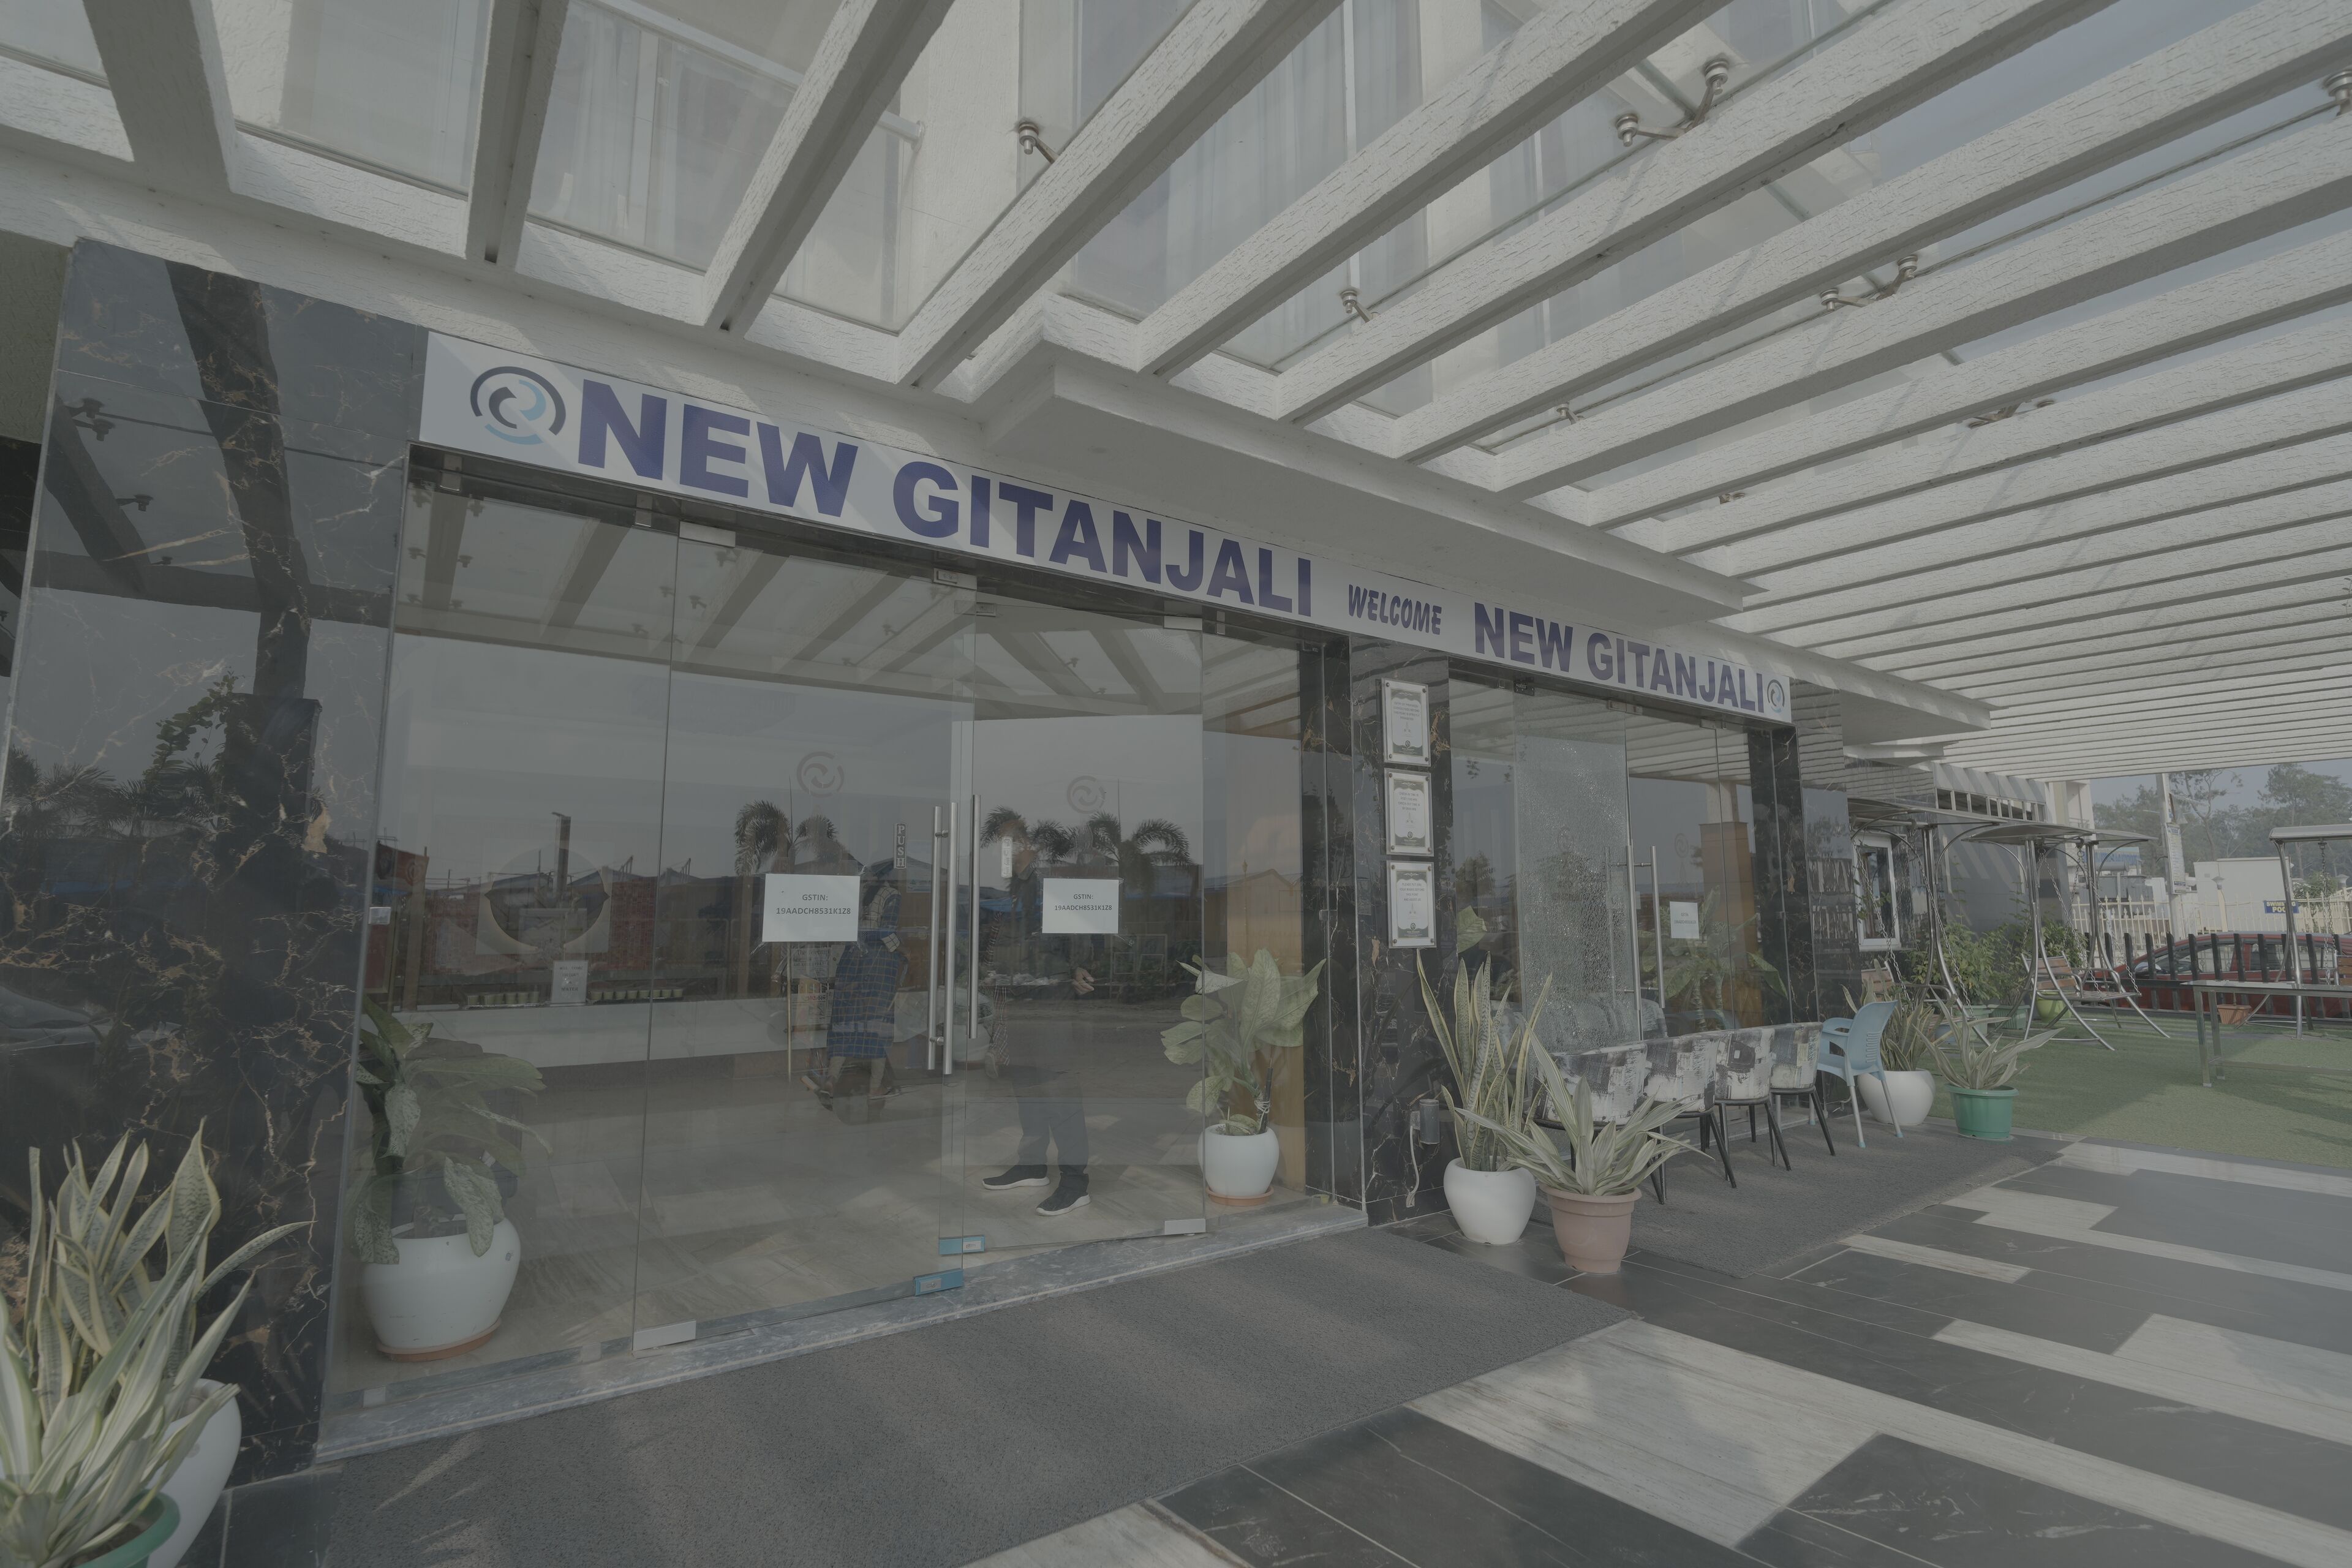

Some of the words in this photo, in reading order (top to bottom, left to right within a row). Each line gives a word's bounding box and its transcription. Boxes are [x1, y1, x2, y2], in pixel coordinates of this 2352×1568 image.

[578, 379, 859, 518] NEW
[893, 461, 1311, 617] GITANJALI
[1348, 584, 1442, 636] WELCOME
[1474, 602, 1574, 673] NEW
[1587, 632, 1764, 713] GITANJALI
[897, 825, 905, 867] PUSH
